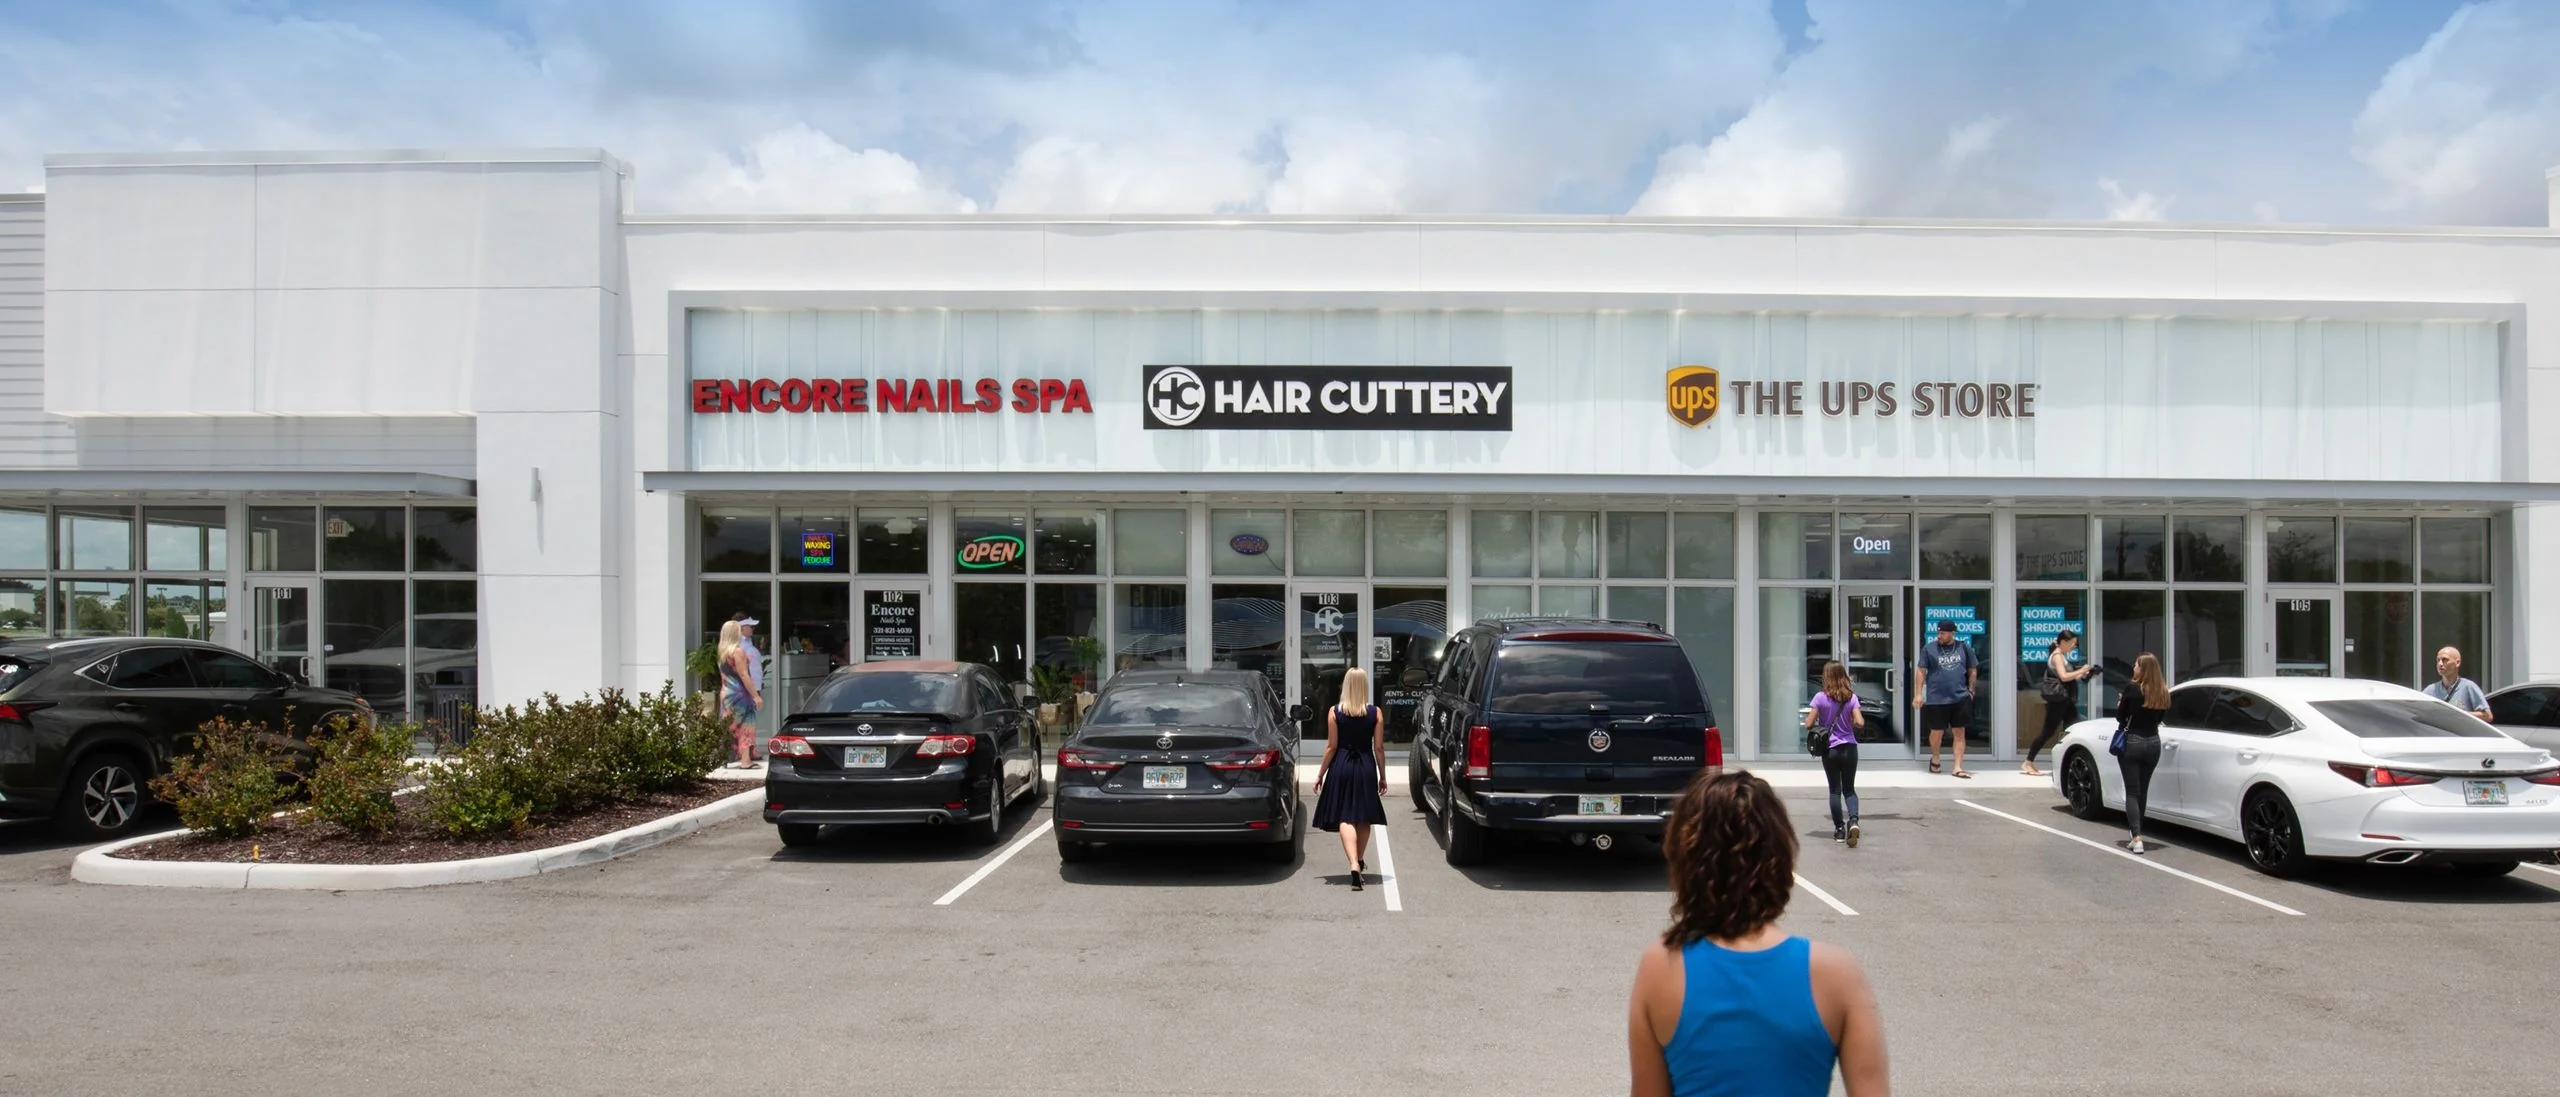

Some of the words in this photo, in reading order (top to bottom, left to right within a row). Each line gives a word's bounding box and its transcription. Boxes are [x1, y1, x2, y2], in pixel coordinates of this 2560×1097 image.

[693, 379, 868, 413] ENCORE
[877, 379, 1002, 413] NAILS
[1012, 379, 1093, 413] SPA
[1215, 380, 1312, 414] HAIR
[1320, 380, 1507, 414] CUTTERY
[1671, 385, 1716, 418] ups
[1730, 380, 1804, 416] THE
[1819, 380, 1899, 417] UPS
[1911, 381, 2035, 418] STORE
[327, 523, 344, 535] EXIT
[804, 541, 831, 549] WAXING
[1853, 536, 1891, 554] Open
[962, 541, 1018, 562] OPEN
[274, 588, 292, 599] 101
[884, 591, 903, 602] 102
[1319, 593, 1339, 605] 103
[1863, 596, 1880, 608] 104
[2291, 599, 2311, 611] 105
[871, 603, 915, 616] Encore
[1927, 608, 1974, 618] PRINTING
[2023, 609, 2062, 619] NOTARY
[2023, 622, 2081, 633] SHREDDING
